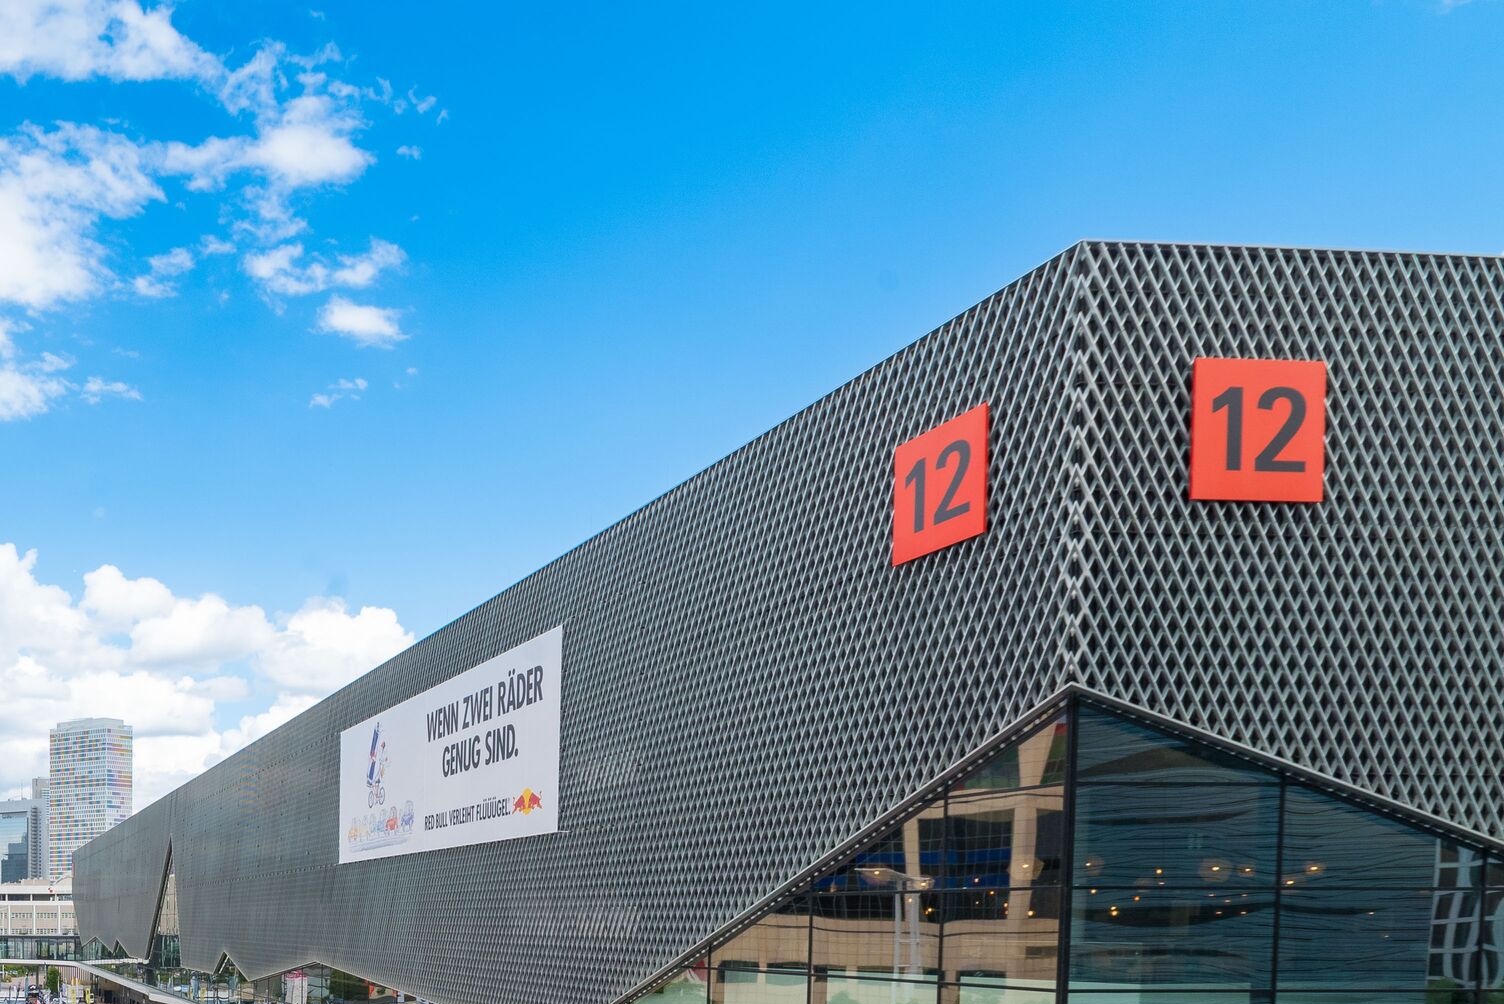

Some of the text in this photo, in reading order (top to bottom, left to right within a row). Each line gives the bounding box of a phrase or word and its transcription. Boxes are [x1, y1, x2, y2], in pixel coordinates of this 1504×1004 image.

[1211, 387, 1306, 473] 12
[905, 438, 972, 533] 12
[427, 665, 543, 742] WENN ZWEI RÄDER
[443, 724, 518, 777] GENUG SIND.
[425, 815, 434, 831] RED
[436, 811, 447, 828] BULL
[449, 805, 475, 825] VERLEIHT
